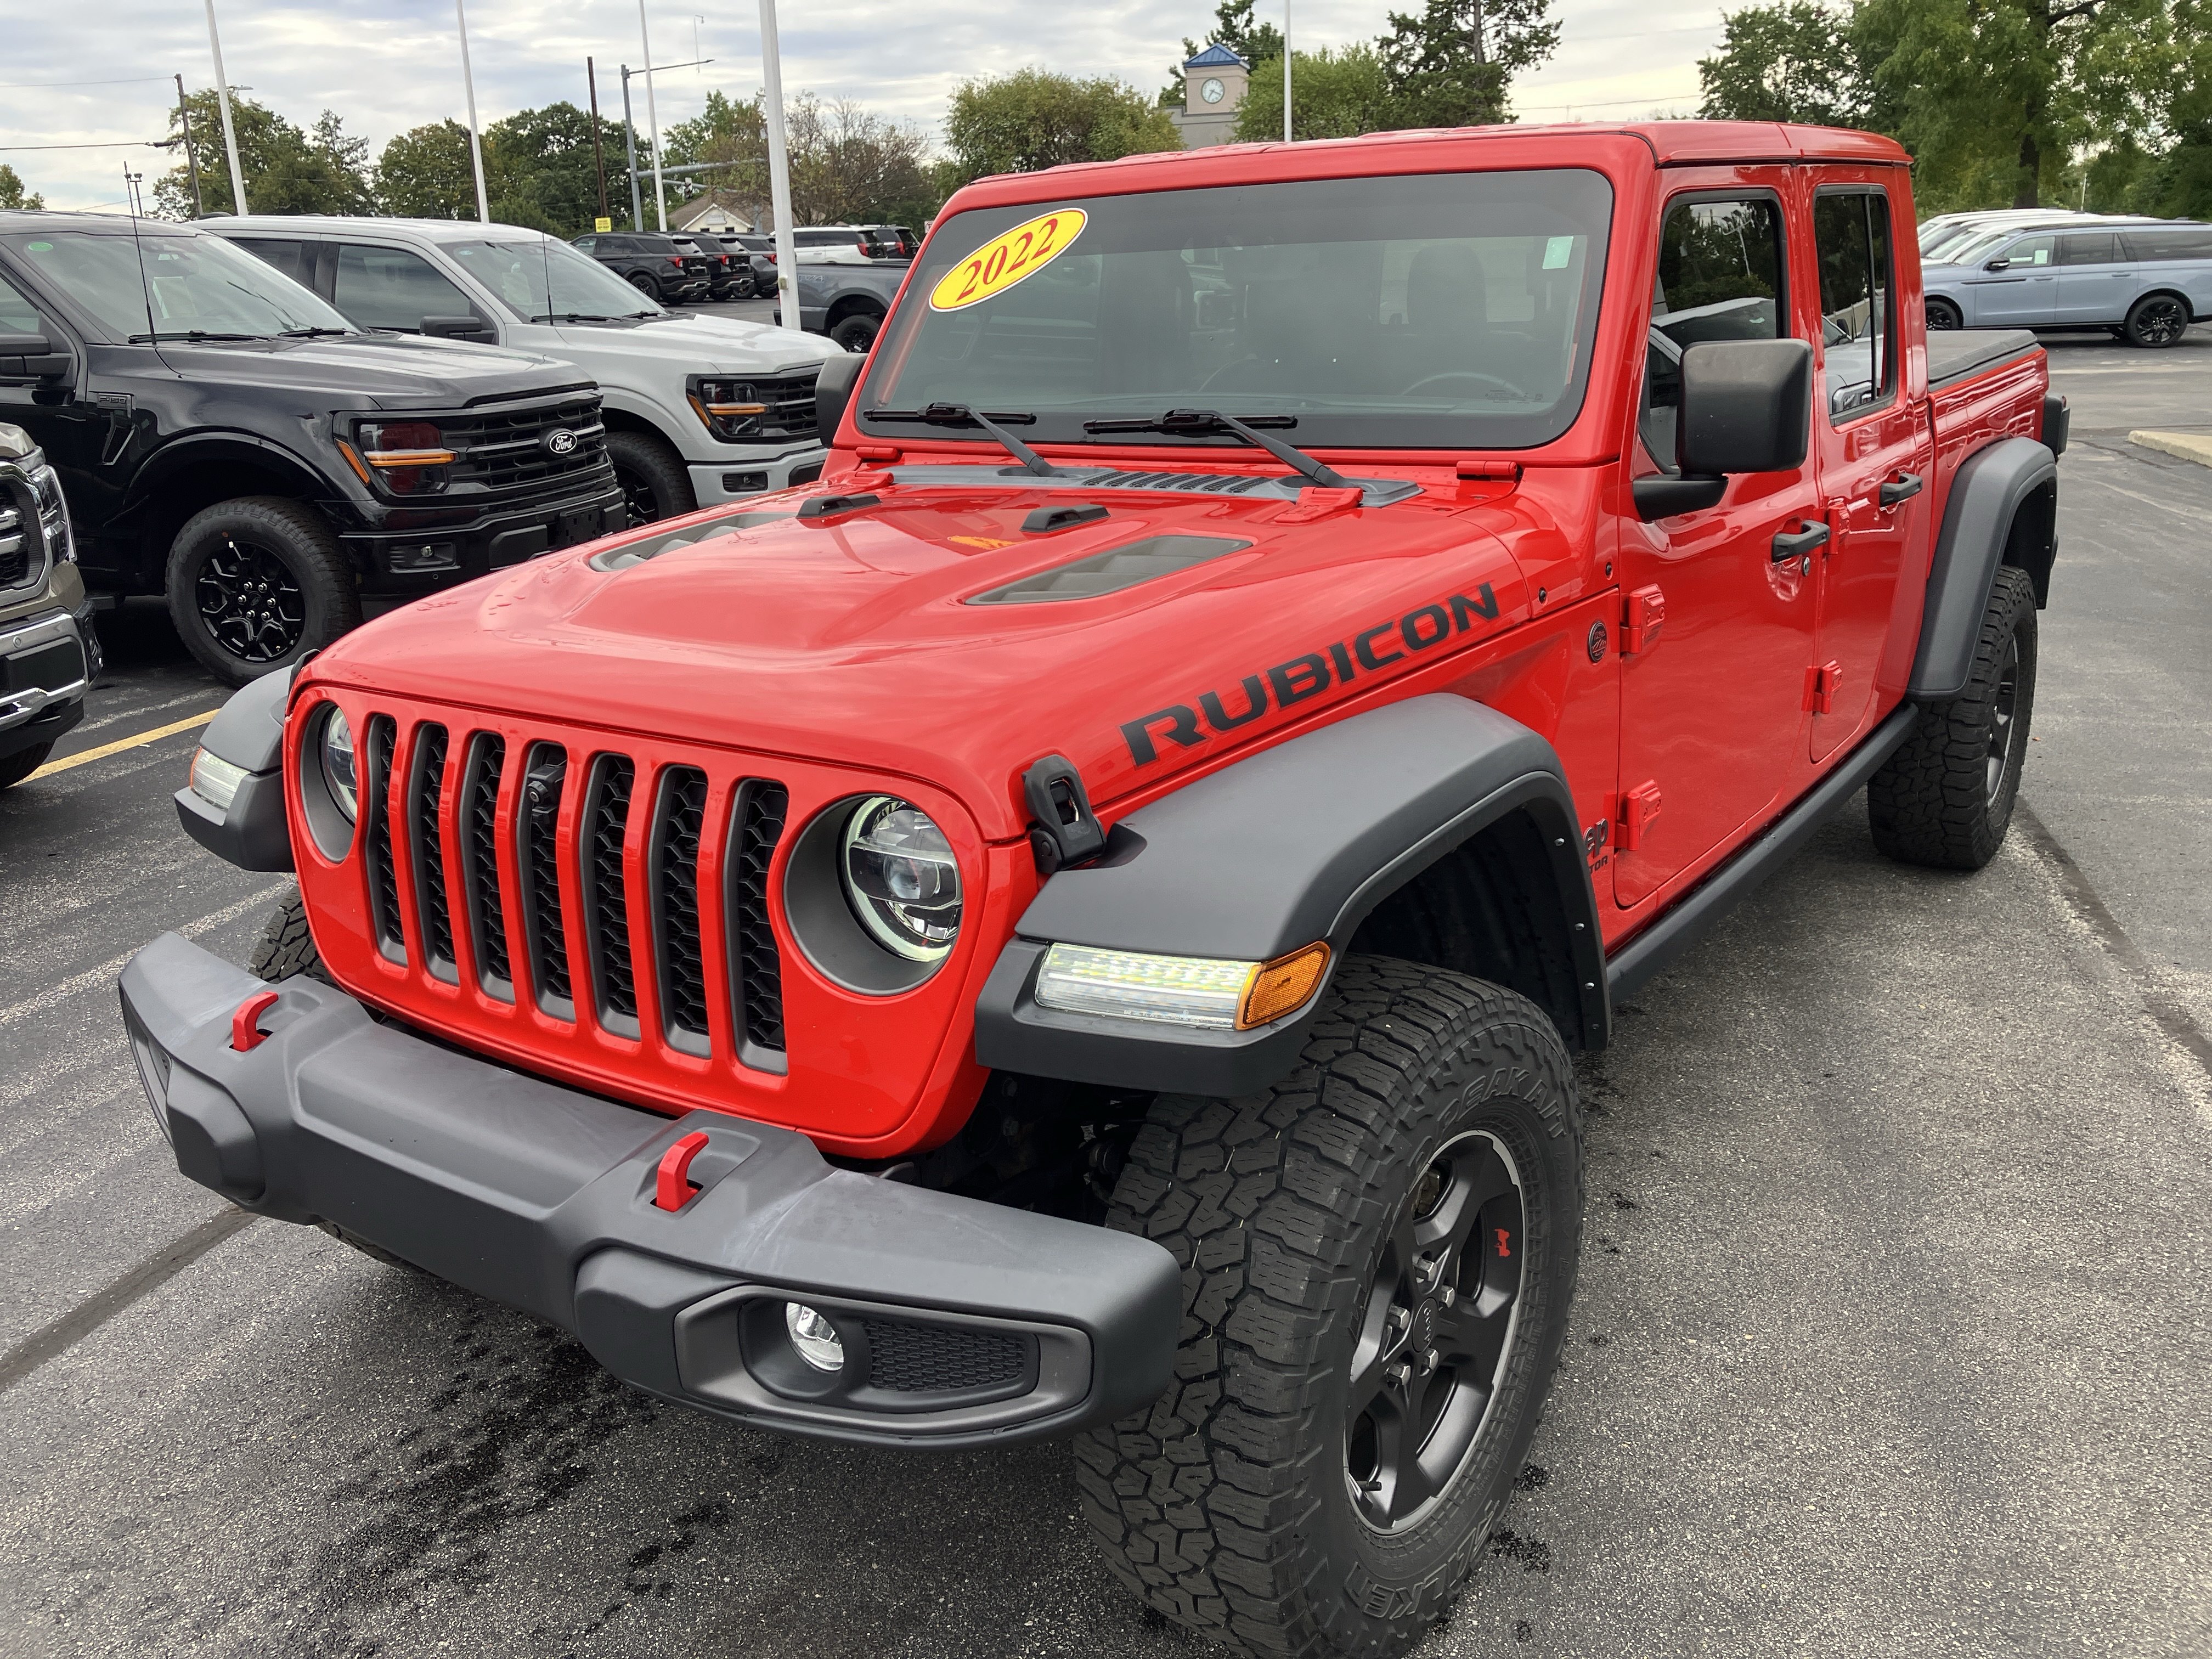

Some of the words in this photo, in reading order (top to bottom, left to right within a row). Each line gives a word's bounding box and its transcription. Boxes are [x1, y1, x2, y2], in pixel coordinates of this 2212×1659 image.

[956, 218, 1058, 302] 2022
[555, 435, 573, 451] Ford
[1119, 582, 1500, 766] RUBICON
